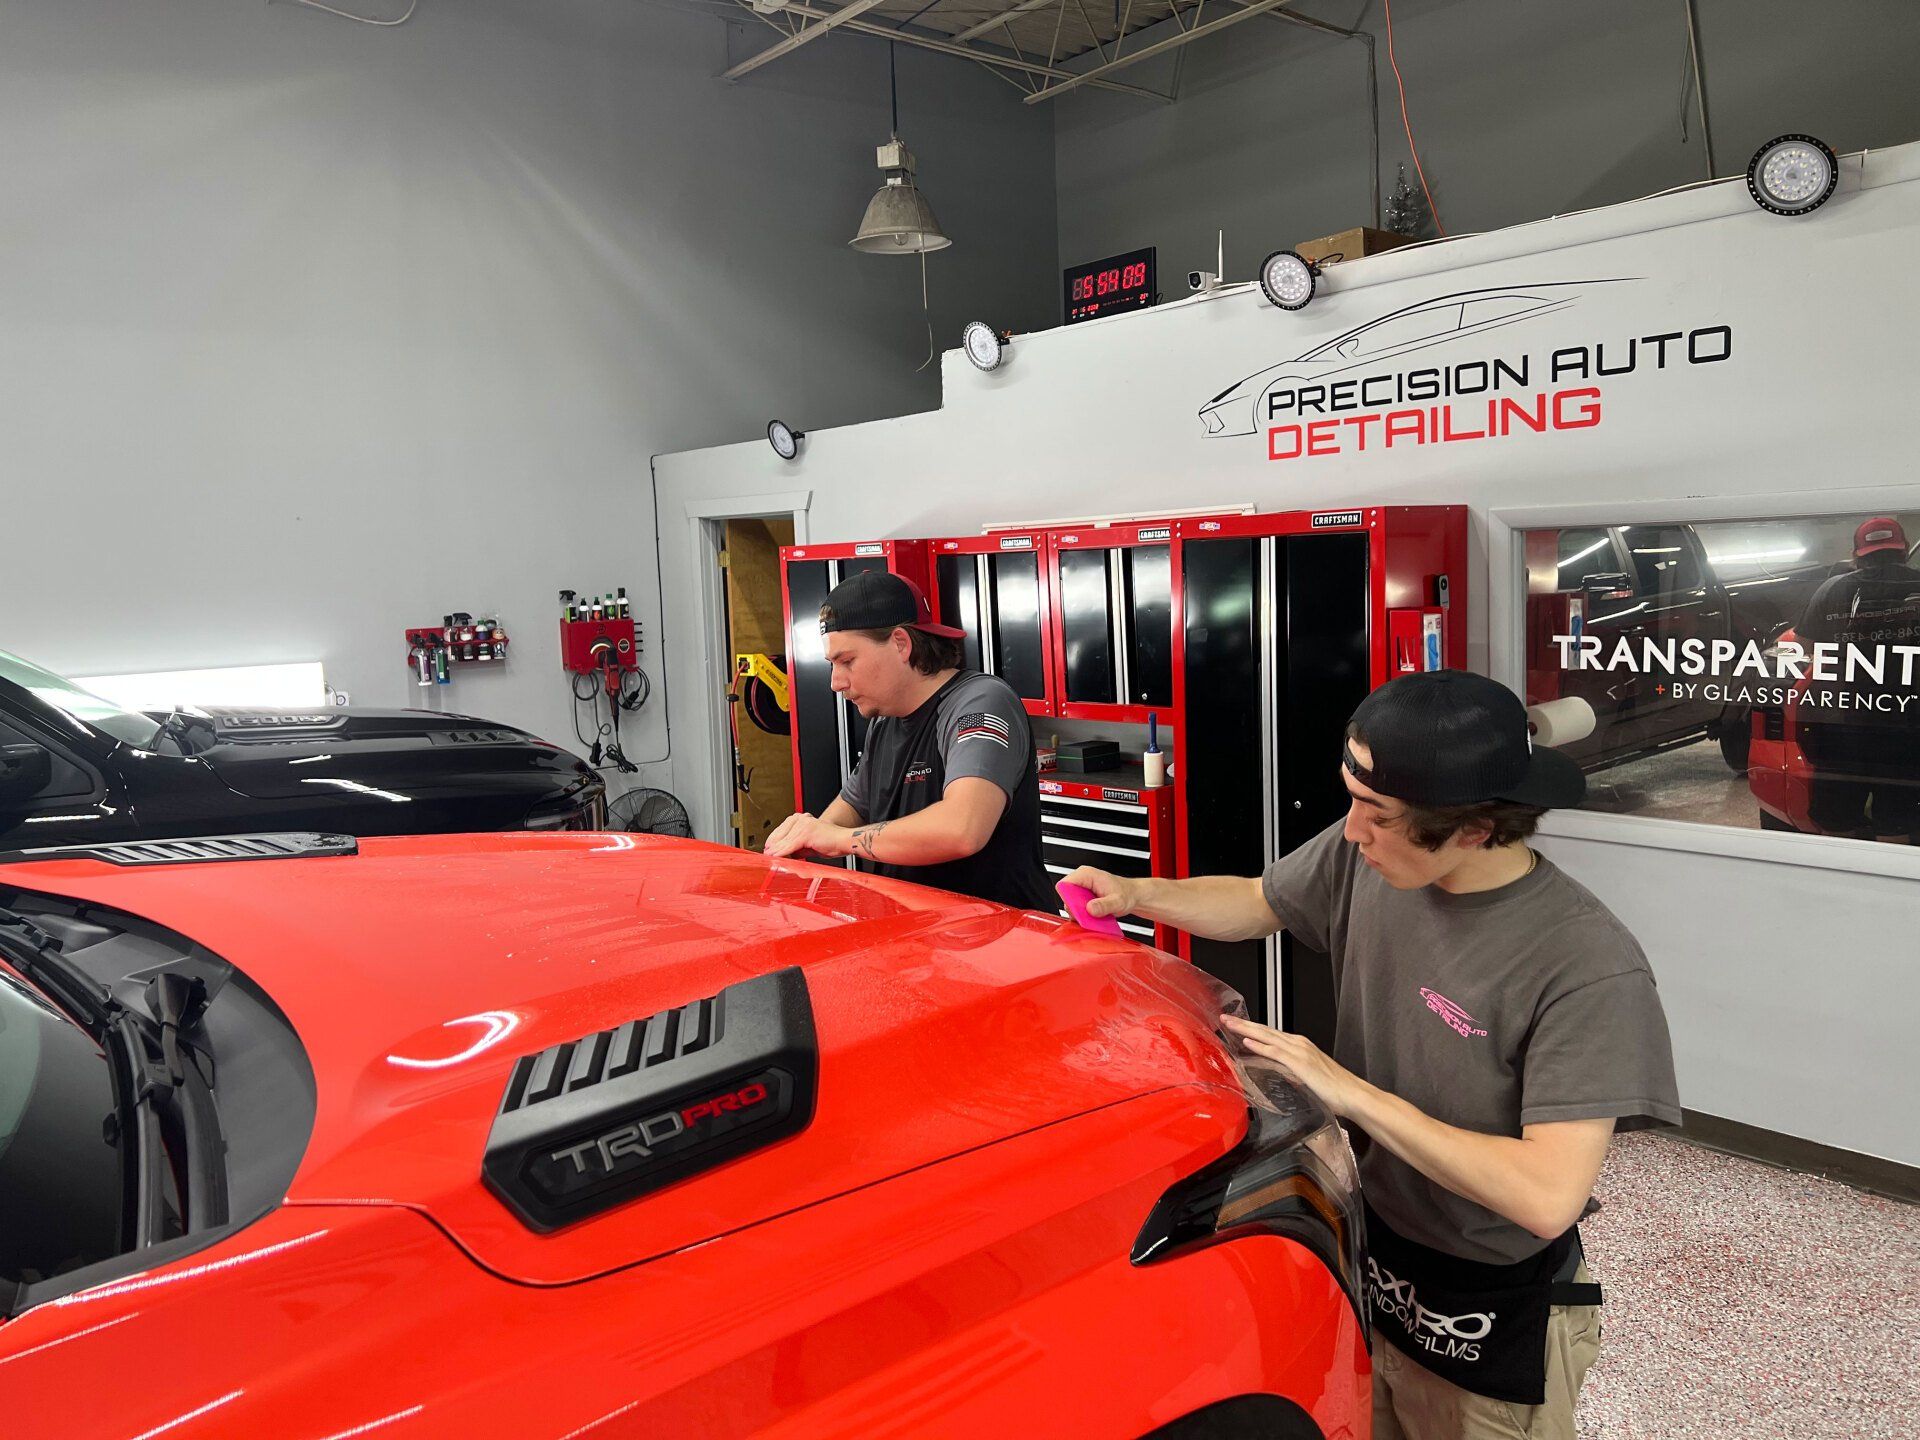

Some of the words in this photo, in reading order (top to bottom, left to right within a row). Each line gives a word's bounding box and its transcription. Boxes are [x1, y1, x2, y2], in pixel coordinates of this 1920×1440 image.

[1268, 355, 1528, 420] PRECISION
[1551, 325, 1731, 382] AUTO
[1268, 387, 1601, 461] DETAILING
[1140, 530, 1170, 539] CRAFTSMA
[1314, 514, 1359, 525] CRAFTSMAN
[1552, 635, 1920, 686] TRANSPARENT
[1672, 683, 1697, 699] BY
[1104, 788, 1137, 801] CRAFTSMAN
[1462, 1022, 1488, 1037] AUTO
[551, 1111, 683, 1173] TRD
[681, 1082, 767, 1128] PRO
[1369, 1284, 1416, 1334] INDOW
[1415, 1331, 1481, 1361] FILMS
